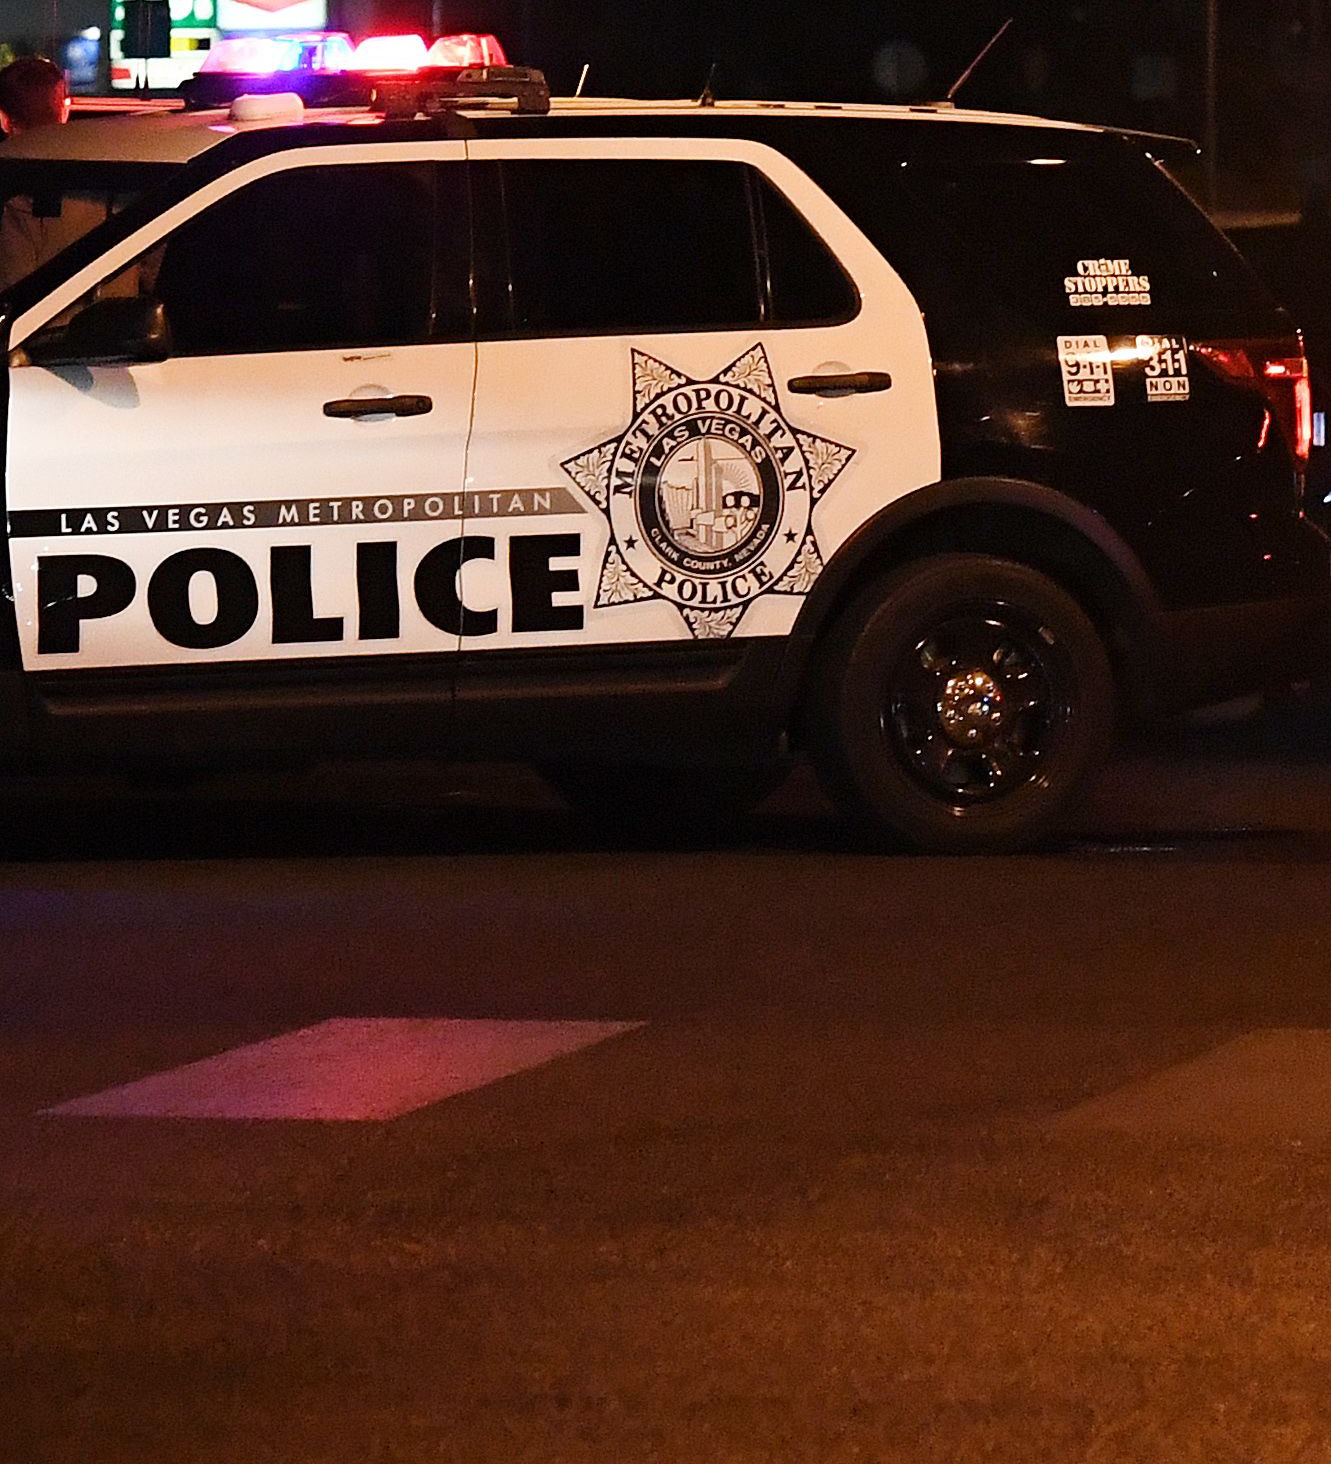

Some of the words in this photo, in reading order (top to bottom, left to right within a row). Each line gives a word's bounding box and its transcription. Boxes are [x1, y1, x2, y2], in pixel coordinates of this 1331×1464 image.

[1064, 276, 1151, 294] STOPPERS
[1076, 258, 1132, 276] CRIME
[1063, 340, 1101, 350] DIAL
[1149, 379, 1187, 392] NON
[613, 387, 807, 499] METROPOLITAN
[649, 425, 690, 467] LAS
[697, 418, 769, 465] VEGAS
[60, 511, 121, 534] LAS
[141, 504, 257, 531] VEGAS
[277, 491, 553, 526] METROPOLITAN
[650, 527, 680, 565] CLARK
[36, 532, 586, 655] POLICE
[652, 561, 774, 605] POLICE
